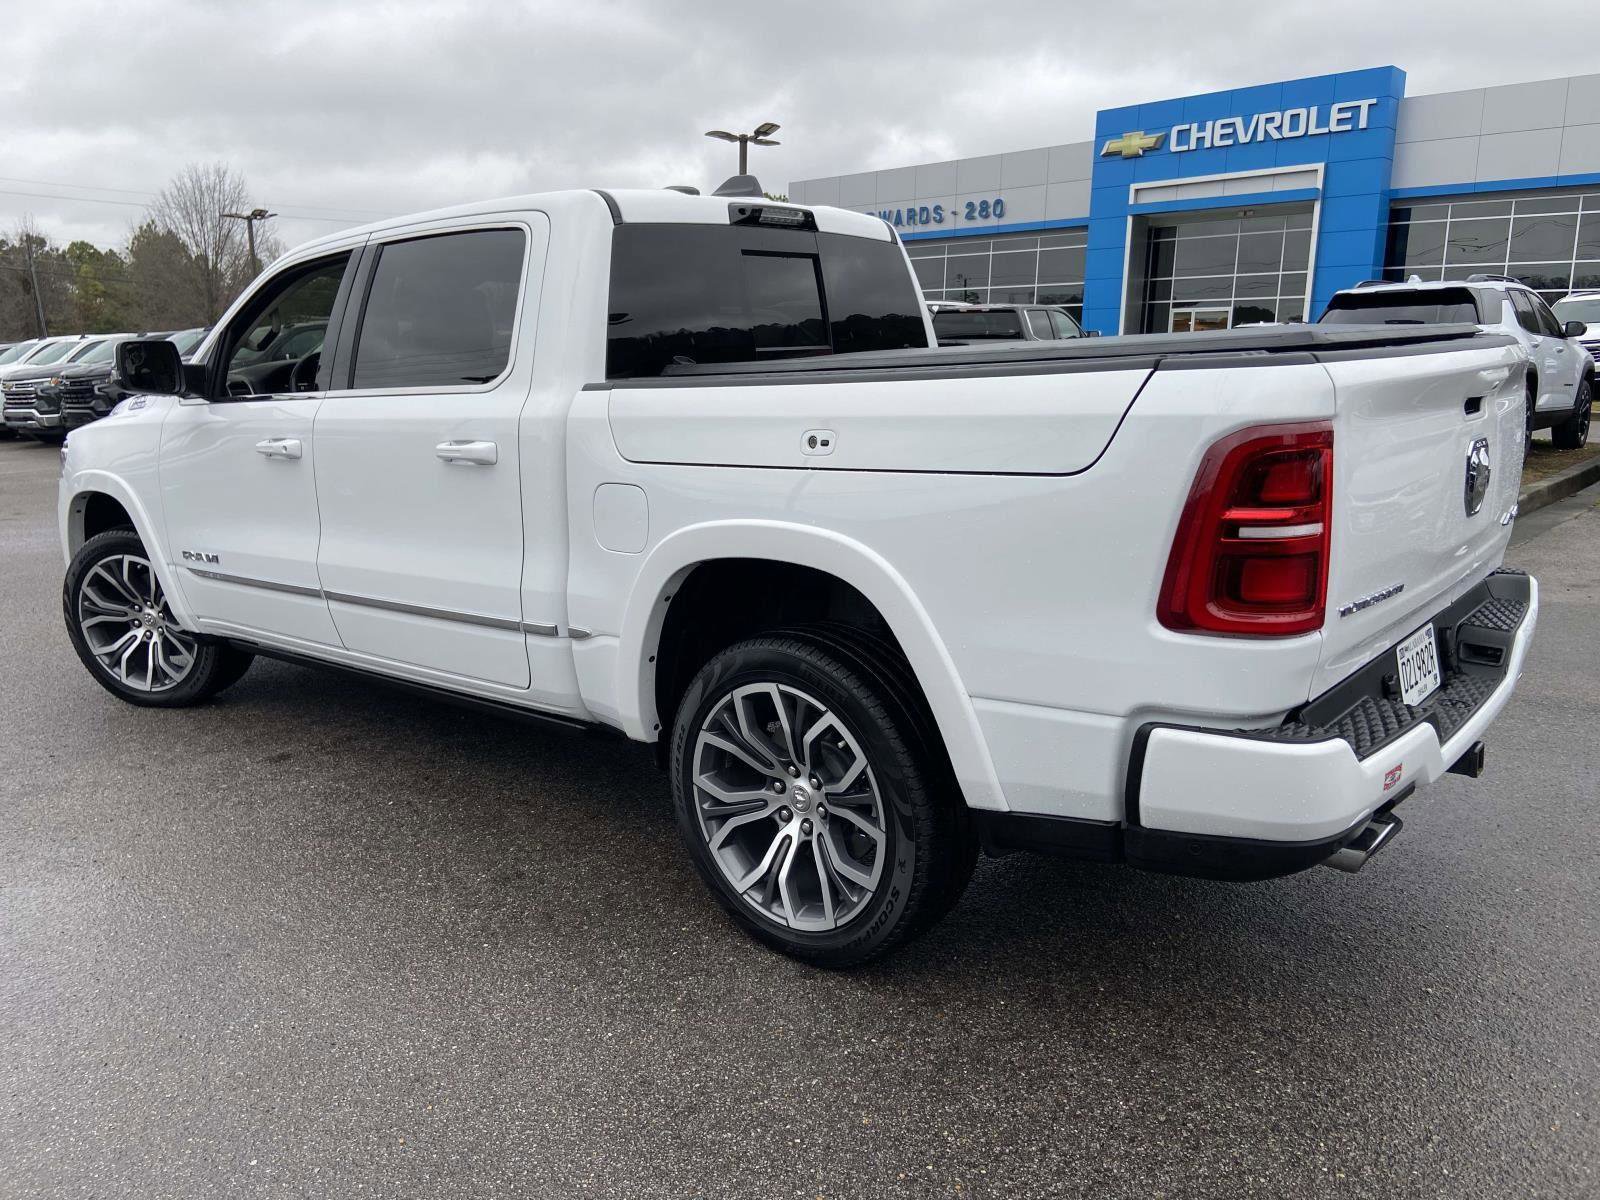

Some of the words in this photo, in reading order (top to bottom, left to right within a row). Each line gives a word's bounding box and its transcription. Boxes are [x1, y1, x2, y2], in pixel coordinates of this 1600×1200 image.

[1169, 98, 1377, 152] CHEVROLET
[866, 204, 944, 227] WARDS
[965, 198, 1005, 220] 280
